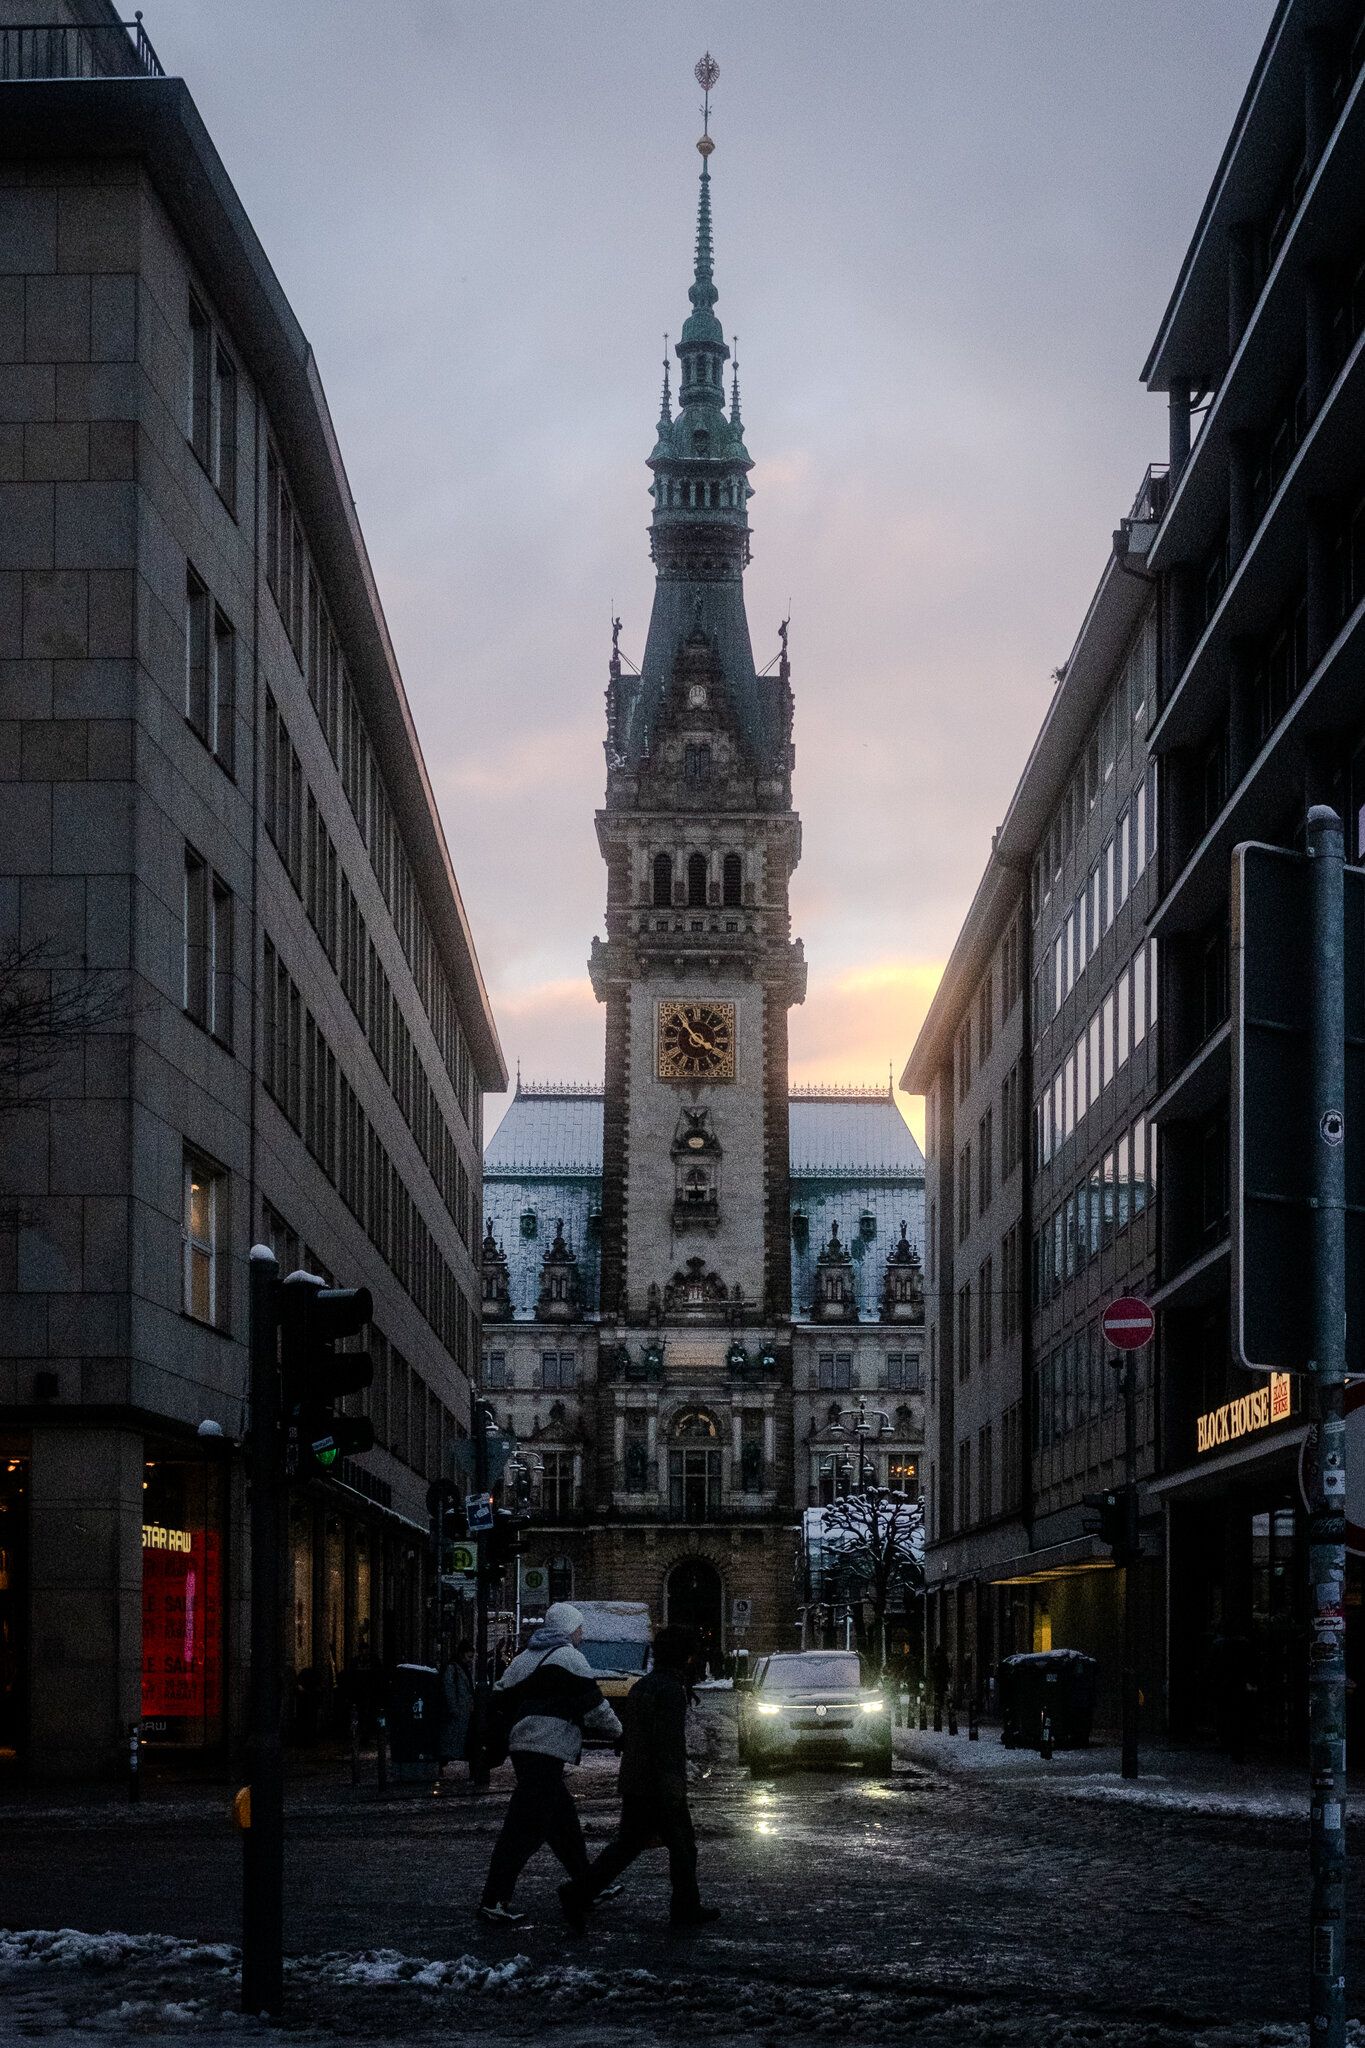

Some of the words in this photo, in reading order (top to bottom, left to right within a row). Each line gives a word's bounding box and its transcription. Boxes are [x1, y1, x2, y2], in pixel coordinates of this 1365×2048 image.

[1197, 1404, 1230, 1453] BLOCK
[1230, 1386, 1270, 1439] HOUSE
[168, 1529, 192, 1553] RAW
